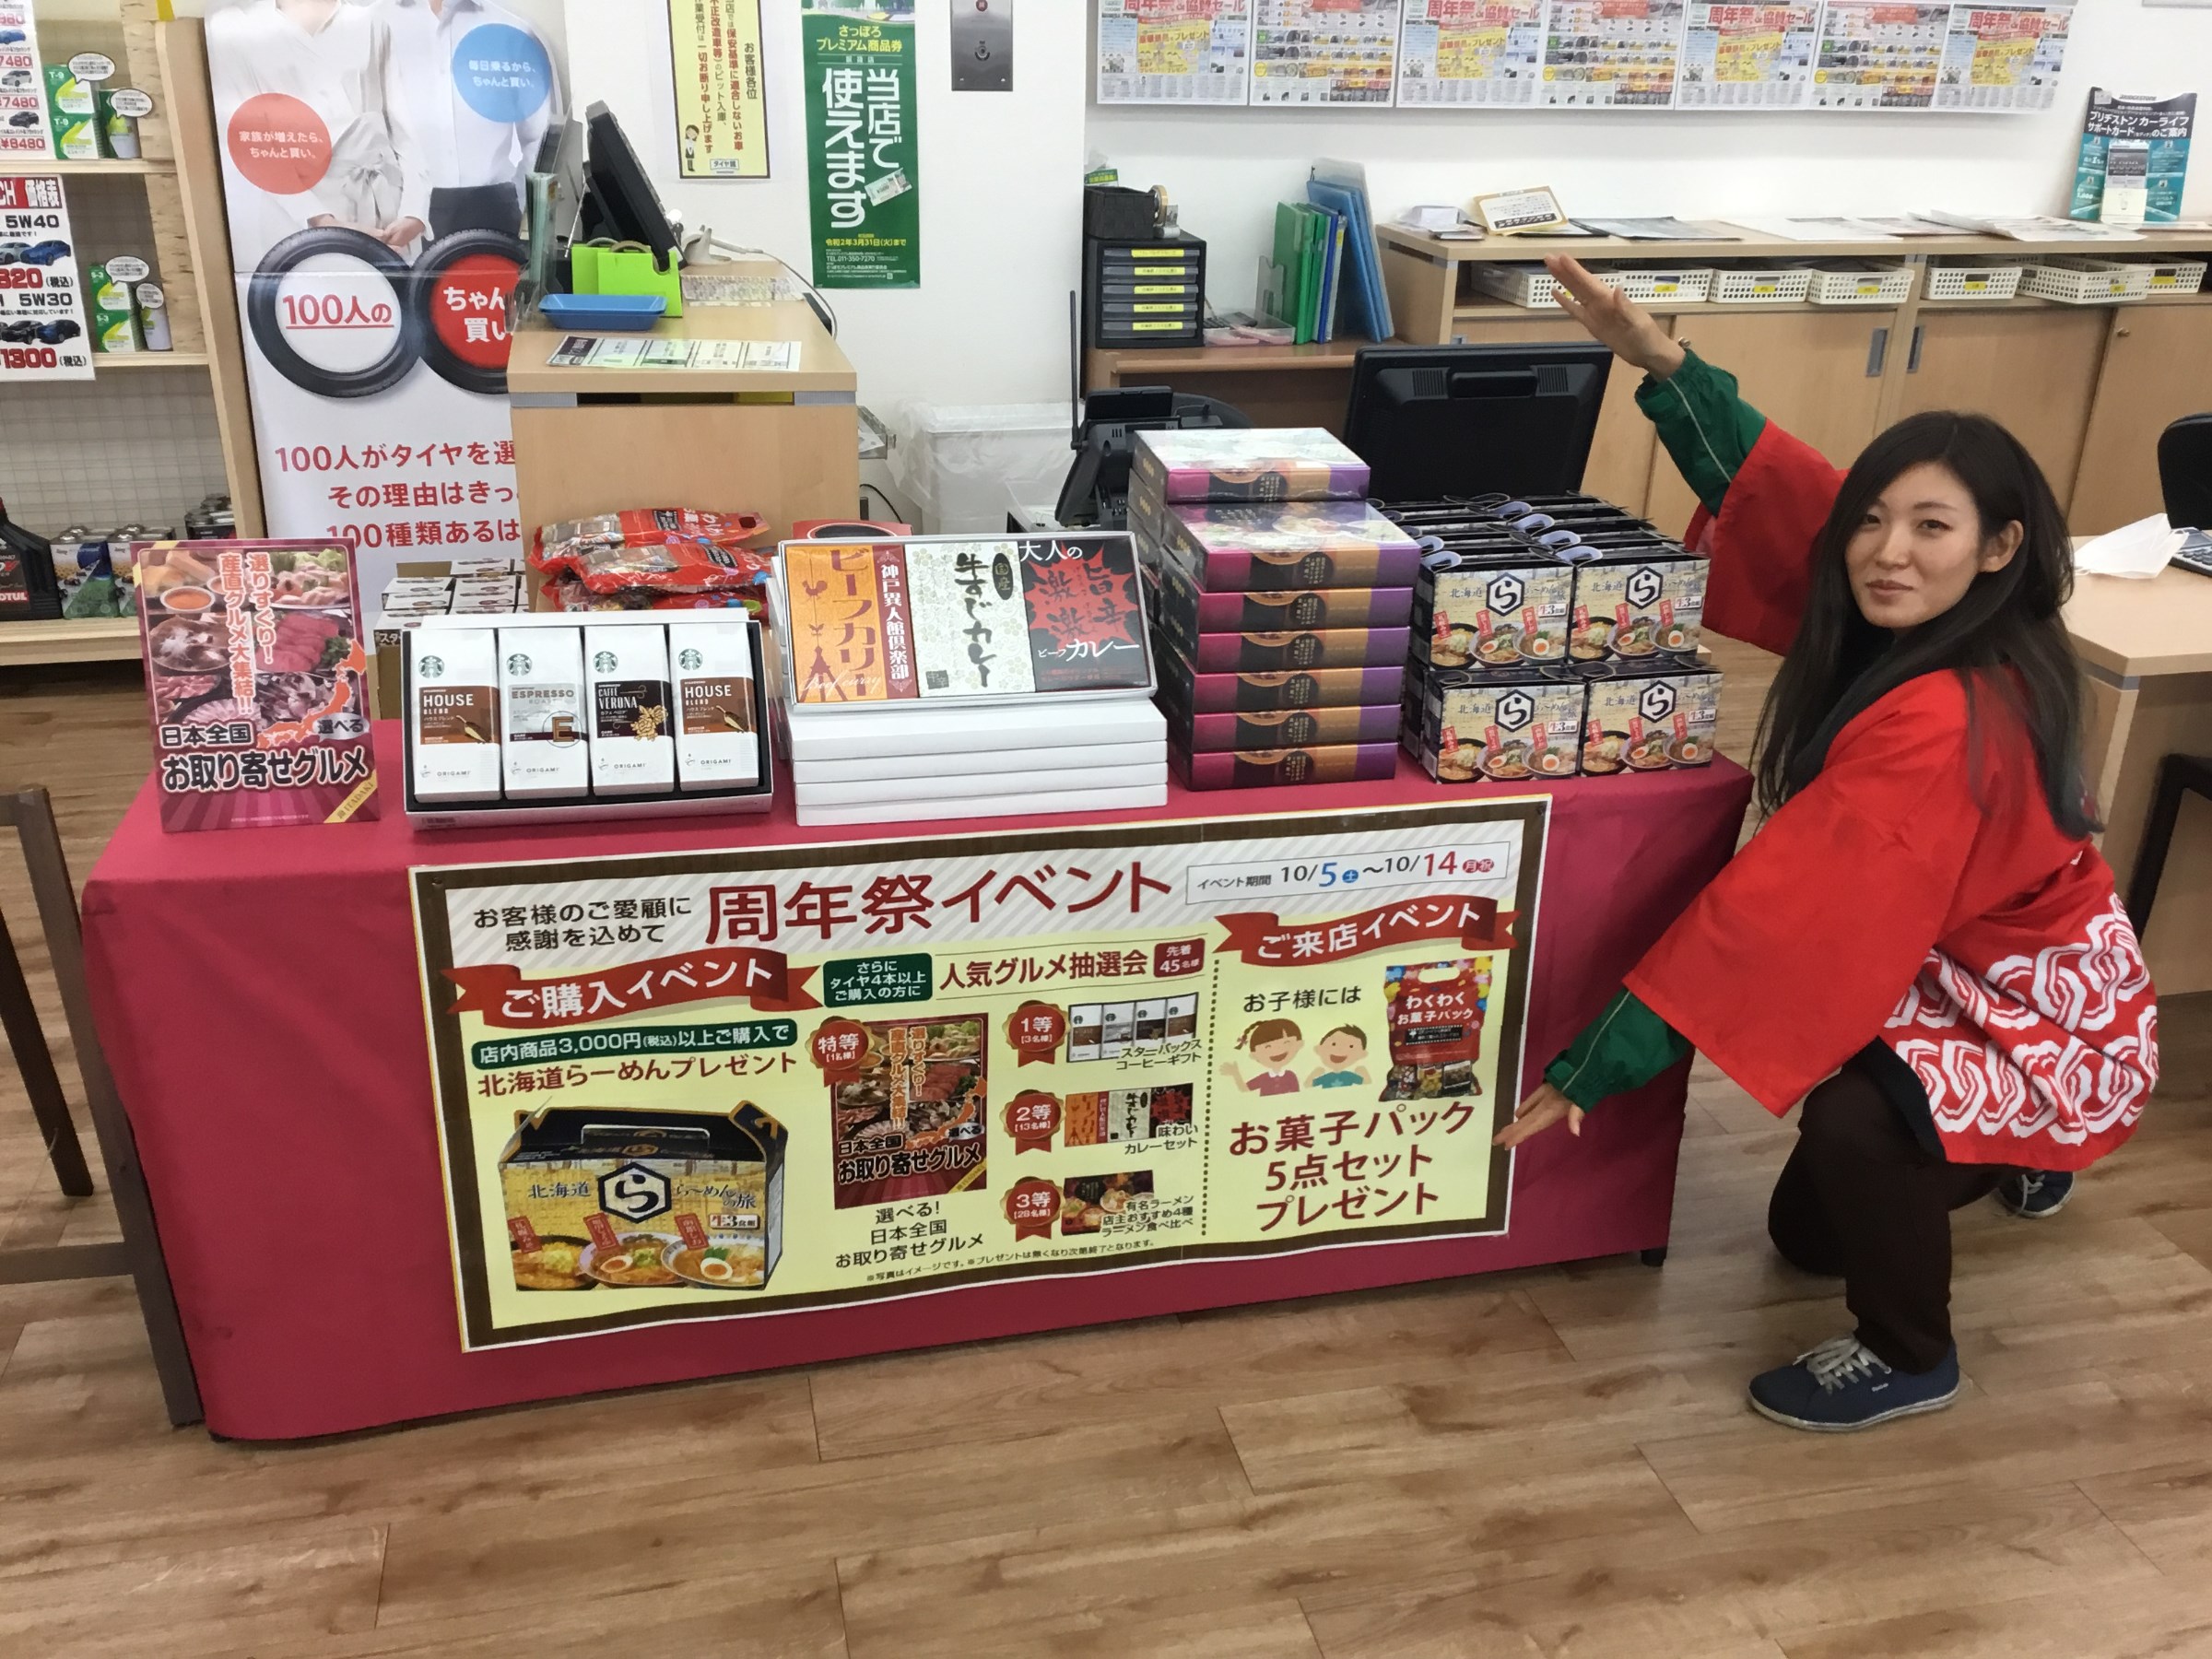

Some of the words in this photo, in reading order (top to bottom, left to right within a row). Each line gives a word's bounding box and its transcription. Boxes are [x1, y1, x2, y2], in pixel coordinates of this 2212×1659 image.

[838, 25, 882, 38] さっぽろ
[816, 38, 902, 53] プレミアム商品券
[468, 60, 537, 74] 毎日乗るから、
[694, 0, 713, 154] 業受付は一切お断り申し上げます
[744, 42, 758, 100] お客様各位
[472, 76, 535, 89] ちゃんと買い。
[866, 68, 902, 169] 当店で
[2139, 116, 2190, 127] カーライフ
[239, 130, 324, 144] 家族が増えたら、
[249, 146, 318, 160] ちゃんと買い。
[821, 67, 867, 229] 使えます
[26, 179, 61, 207] 価格表
[6, 214, 60, 229] 5W40
[19, 292, 73, 307] 5W30
[281, 293, 393, 325] 100人の
[274, 439, 516, 473] 100人がタイヤを選
[327, 480, 519, 509] その理由はきっ
[325, 518, 522, 549] 100種類あるは
[1018, 539, 1083, 562] 大人の
[994, 562, 1011, 591] 国産
[1449, 587, 1483, 598] 北海道
[1591, 581, 1623, 593] 北海道
[248, 552, 276, 665] 選りすぐり!
[830, 547, 877, 697] ビーフカリー
[880, 564, 910, 680] 神戸異人館倶楽部
[954, 553, 997, 688] 牛すじカレー
[219, 553, 254, 714] 産直グルメ大集結!!
[379, 632, 401, 643] スタ
[423, 693, 475, 708] HOUSE
[512, 689, 575, 700] ESPRESSO
[685, 684, 733, 699] HOUSE
[1605, 695, 1637, 707] 北海道
[599, 696, 638, 710] VERONA
[1458, 702, 1491, 714] 北海道
[160, 724, 253, 747] 日本全国
[317, 718, 365, 735] 選べる
[162, 747, 368, 792] お取り寄せグルメ
[1196, 874, 1272, 891] イベント期間
[473, 896, 692, 930] お客様のご愛顧に
[705, 860, 1172, 946] 周年祭イベント
[504, 924, 666, 953] 感謝を込めて
[1256, 900, 1480, 960] ご来店イベント
[1166, 944, 1192, 957] 先着
[856, 959, 899, 975] さらに
[938, 948, 1148, 992] 人気グルメ抽選会
[1159, 958, 1200, 973] 45名様
[500, 957, 774, 1020] ご購入イベント
[830, 971, 927, 991] タイヤ4本以上
[834, 984, 923, 1003] ご購入の方に
[1243, 985, 1362, 1013] お子様には
[1406, 991, 1465, 1010] わくわく
[1020, 1016, 1053, 1033] 1等
[1397, 1007, 1474, 1025] お菓子パック
[478, 1023, 790, 1065] 店内商品3,000円(税込)以上ご購入で
[818, 1031, 861, 1053] 特等
[1121, 1039, 1202, 1059] スターバックス
[1116, 1052, 1202, 1070] コーヒーギフト
[477, 1051, 798, 1098] 北海道らーめんプレゼント
[1016, 1103, 1052, 1123] 2等
[947, 1123, 982, 1140] 選べる
[1158, 1124, 1199, 1138] 味わい
[1229, 1101, 1476, 1157] お菓子パック
[837, 1134, 903, 1156] 日本全国
[1124, 1136, 1198, 1155] カレーセット
[836, 1142, 982, 1185] お取り寄せグルメ
[1265, 1144, 1433, 1192] 5点セット
[527, 1181, 592, 1199] 北海道
[614, 1173, 660, 1214] ら
[1016, 1190, 1052, 1208] 3等
[875, 1200, 941, 1225] 選べる!
[1125, 1195, 1194, 1212] 有名ラーメン
[1256, 1182, 1440, 1231] プレゼント
[1102, 1206, 1194, 1226] 店主おすすめ4種
[870, 1218, 948, 1246] 日本全国
[1100, 1218, 1194, 1238] ラーメン食べ比べ
[834, 1231, 985, 1270] お取り寄せグルメ
